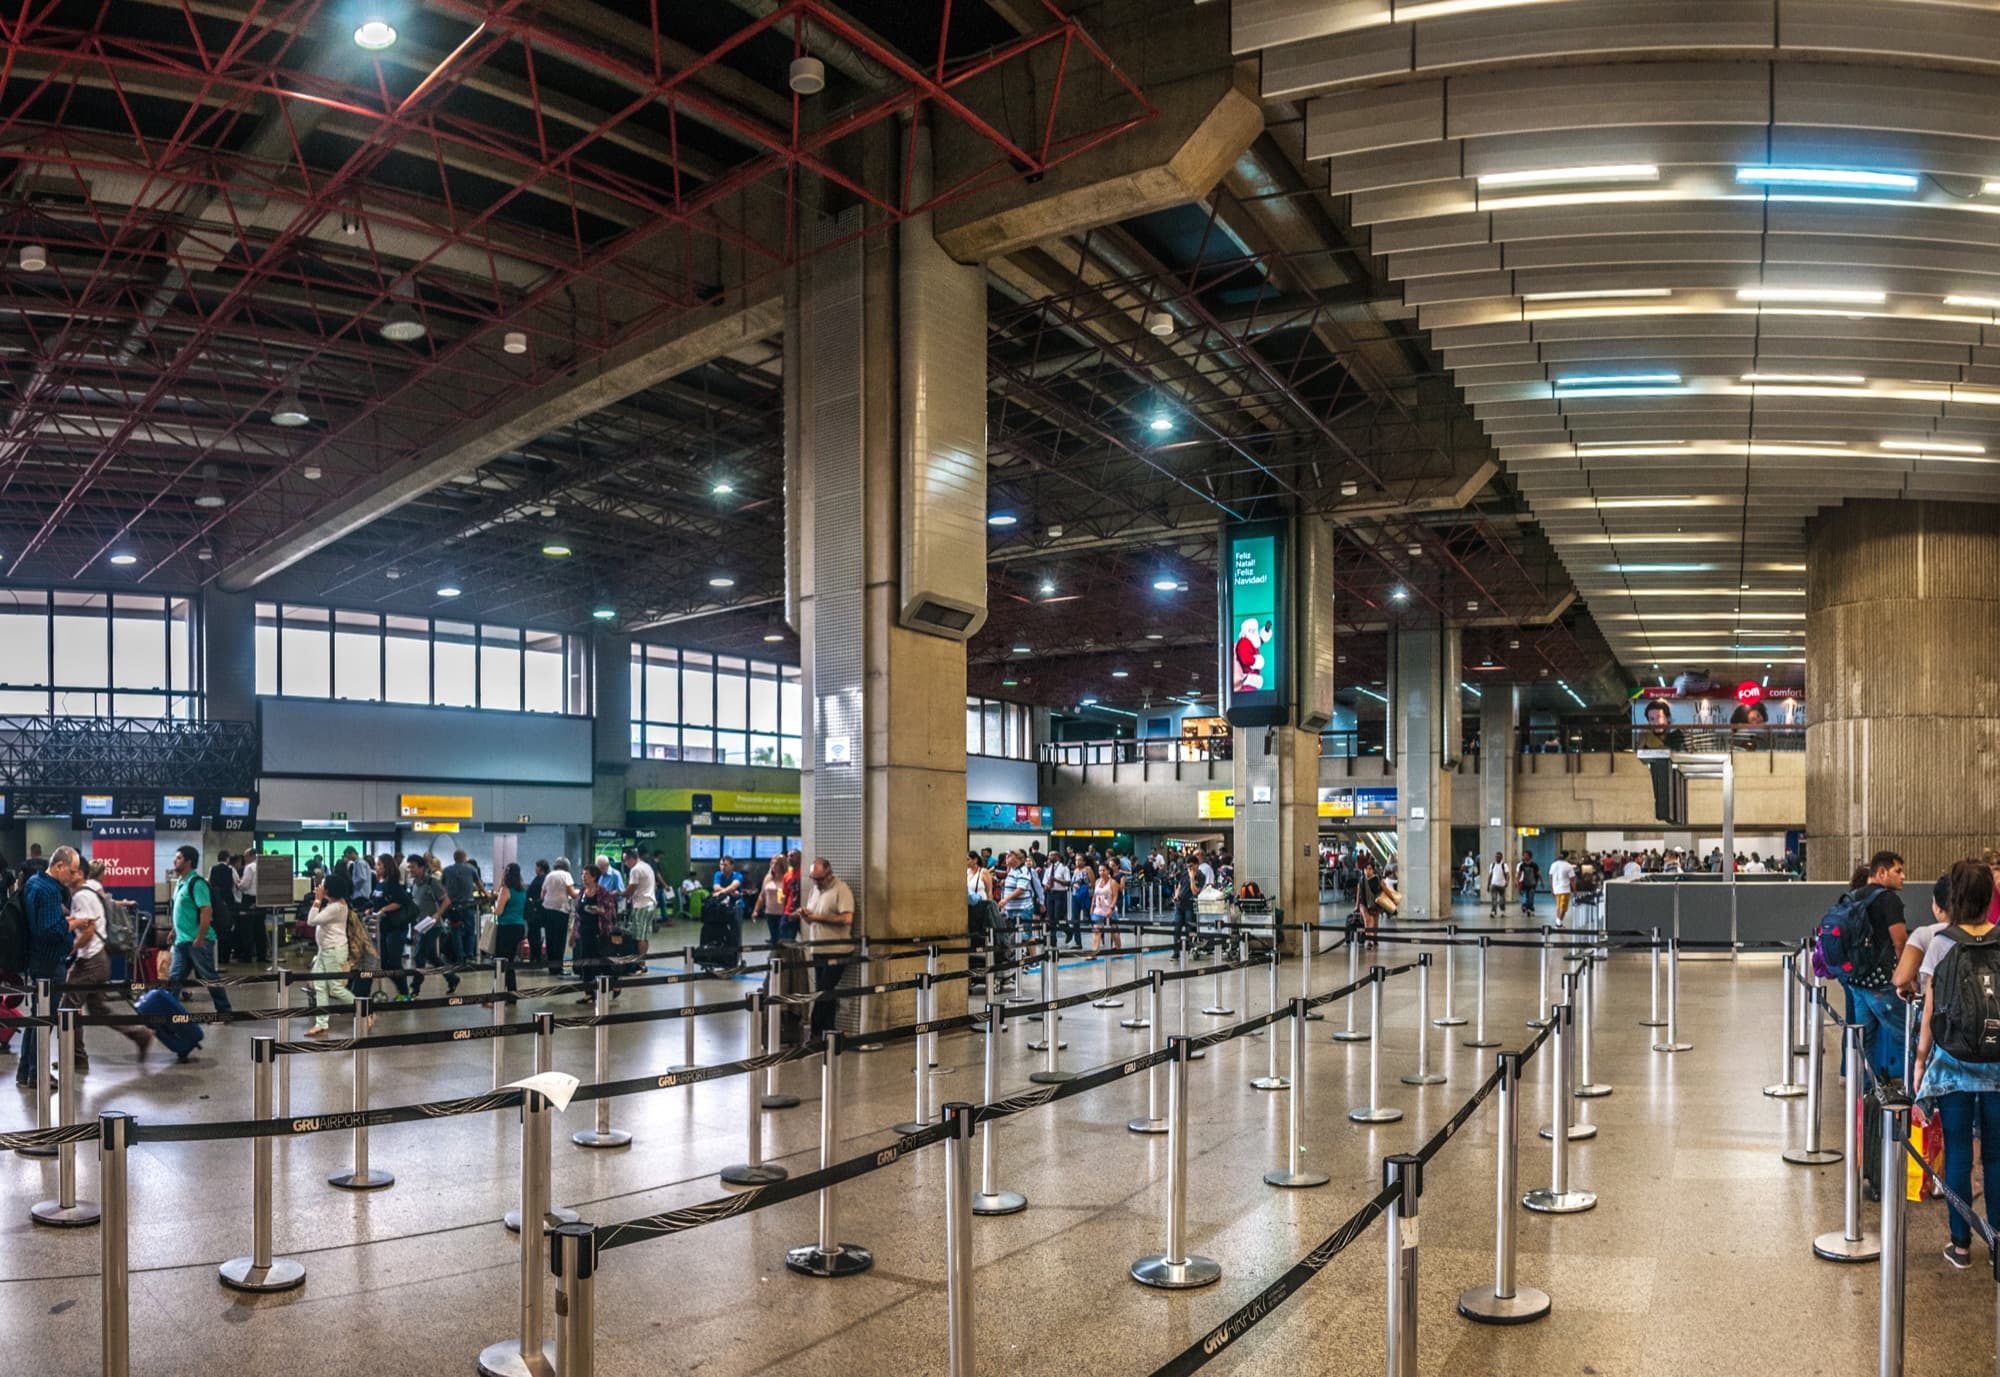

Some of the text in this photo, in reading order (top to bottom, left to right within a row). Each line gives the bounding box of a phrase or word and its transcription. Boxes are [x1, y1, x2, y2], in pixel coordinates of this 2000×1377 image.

[1235, 552, 1251, 560] Feliz
[1236, 559, 1256, 568] Natal!
[1235, 575, 1267, 584] Navidad!
[169, 818, 188, 829] D56
[225, 819, 243, 830] D57
[109, 827, 139, 835] DELTA
[104, 866, 150, 876] RIORITY
[172, 1014, 189, 1024] GRU
[453, 1029, 471, 1040] GRU
[658, 1074, 677, 1088] GRU
[292, 1117, 320, 1132] GRU
[320, 1112, 367, 1130] AIRPORT
[877, 1146, 897, 1166] GRU
[1203, 1321, 1229, 1354] GRU
